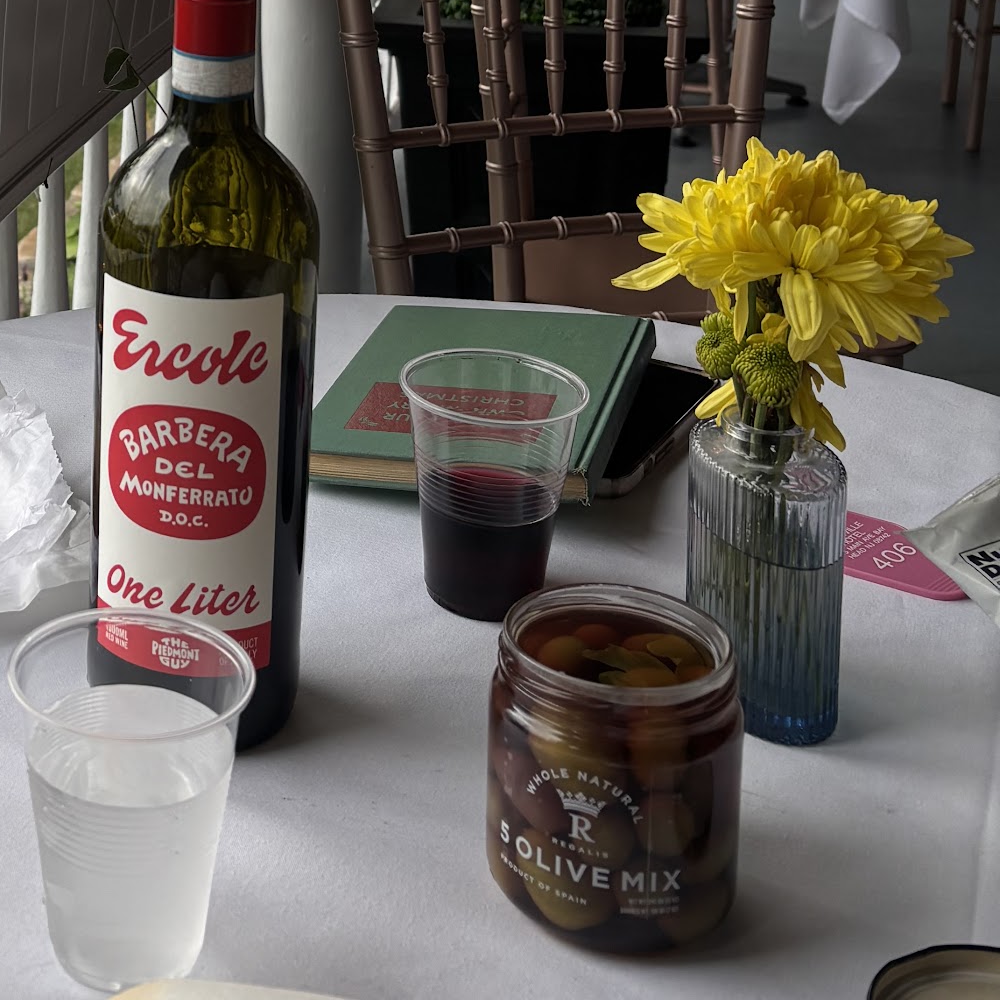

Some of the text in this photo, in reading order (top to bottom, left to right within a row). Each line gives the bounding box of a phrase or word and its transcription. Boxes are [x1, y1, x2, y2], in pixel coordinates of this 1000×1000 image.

[112, 308, 268, 385] Ercole
[119, 417, 252, 473] BARBERA
[155, 457, 214, 479] DEL
[119, 470, 253, 508] MONFERRATO
[159, 509, 209, 527] D.O.C.
[847, 540, 864, 551] MAIN
[848, 547, 867, 560] HEAD
[872, 542, 917, 570] 406
[106, 564, 260, 616] One Liter
[114, 636, 128, 650] WINE
[152, 640, 200, 661] PIEDMONT
[160, 637, 189, 649] THE
[159, 656, 190, 669] GUY
[526, 768, 646, 825] WHOLE NATURAL
[567, 812, 596, 844] R
[499, 820, 682, 893] 5 OLIVE MIX
[551, 837, 609, 859] REGALIS
[500, 853, 588, 906] PRODUCT OF SPAIN
